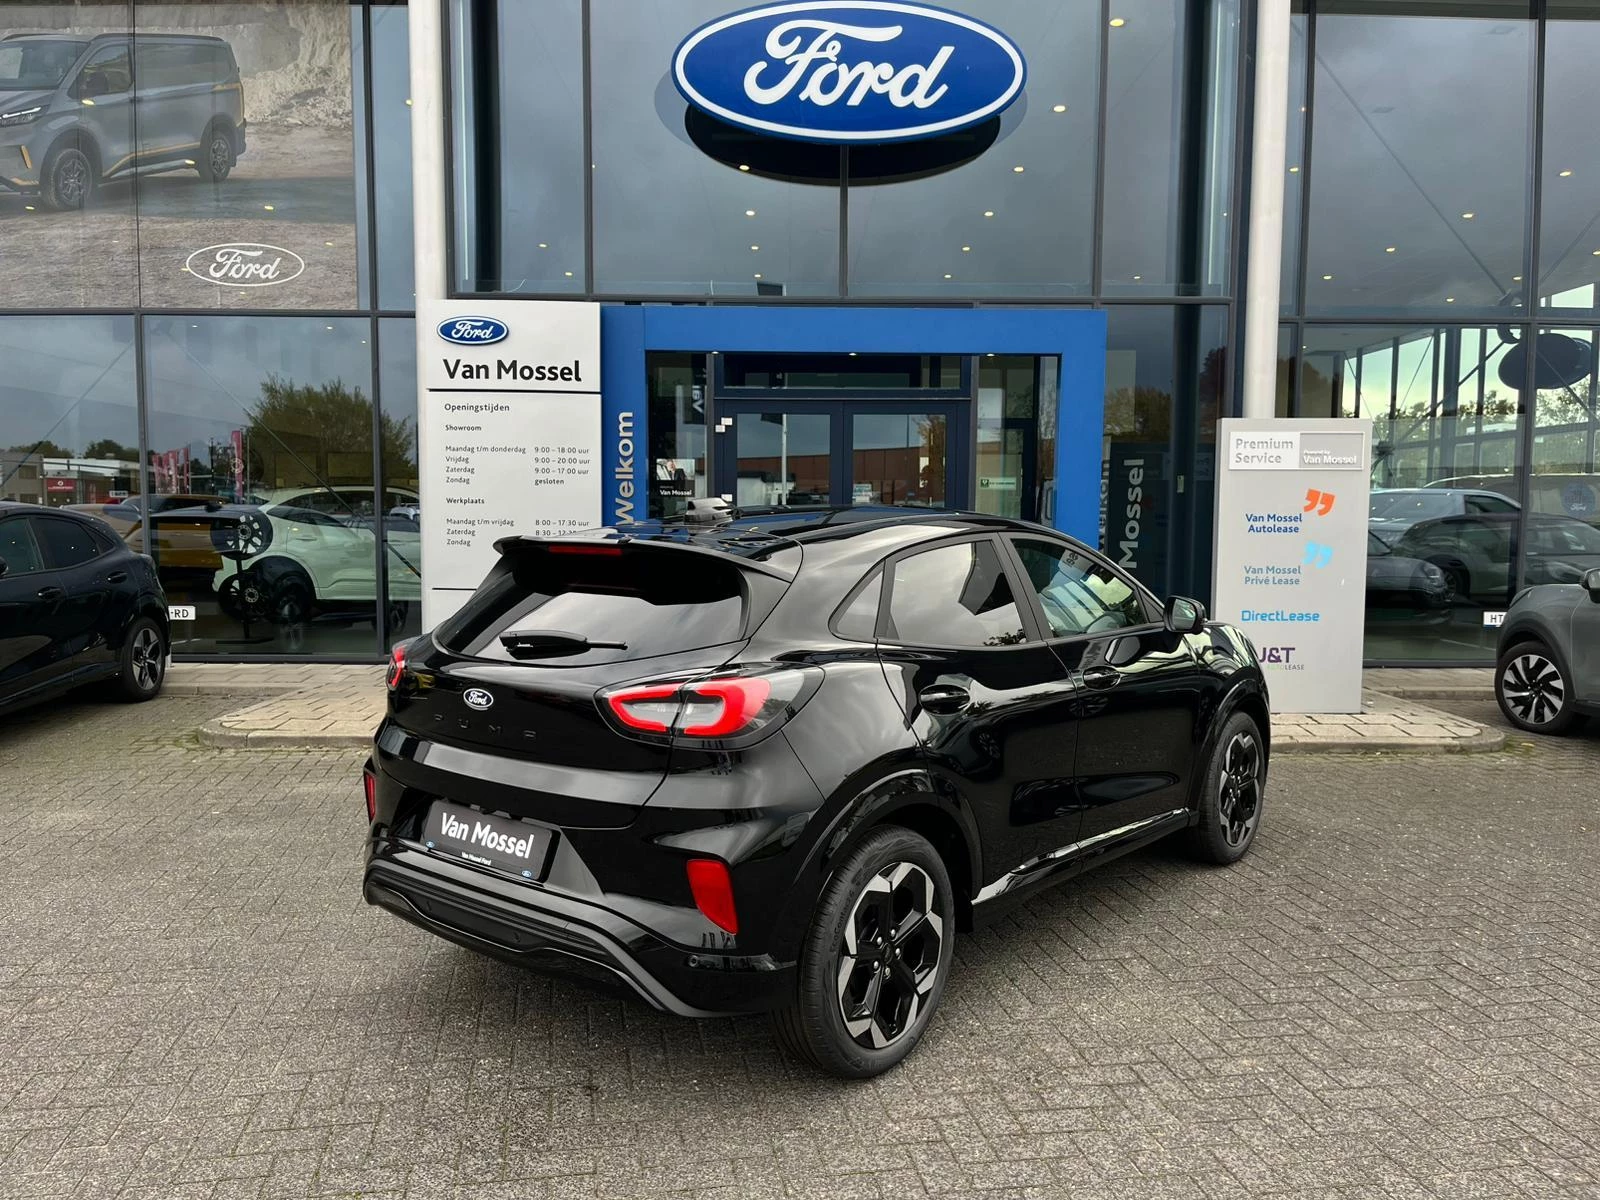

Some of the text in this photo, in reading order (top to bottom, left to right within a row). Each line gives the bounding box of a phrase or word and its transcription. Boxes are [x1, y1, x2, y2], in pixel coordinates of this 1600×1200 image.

[743, 19, 955, 109] Ford
[209, 248, 282, 279] Ford
[451, 320, 494, 339] Ford
[443, 359, 582, 382] Van Mossel
[444, 403, 510, 413] Openingstijden
[1235, 438, 1294, 449] Premium
[445, 445, 474, 453] Maandag
[490, 445, 526, 454] donderdag
[445, 456, 469, 464] Vrijdag
[1235, 452, 1282, 464] Service
[1303, 455, 1357, 464] Van Mossel
[445, 466, 475, 475] Zaterdag
[615, 411, 634, 525] Welkom
[445, 476, 565, 486] Zondag gesloten
[1118, 459, 1144, 569] Mossel
[1245, 513, 1302, 522] Van Mossel
[446, 518, 475, 526] Maandag
[492, 519, 514, 527] vrijdag
[446, 528, 476, 536] Zaterdag
[1248, 524, 1300, 533] Autolease
[446, 538, 471, 547] Zondag
[1244, 565, 1302, 574] Van Mossel
[1244, 576, 1300, 585] Privé Lease
[1241, 610, 1320, 622] DirectLease
[1259, 647, 1296, 663] J&T
[468, 690, 488, 705] Ford
[441, 812, 535, 859] Van Mossel
